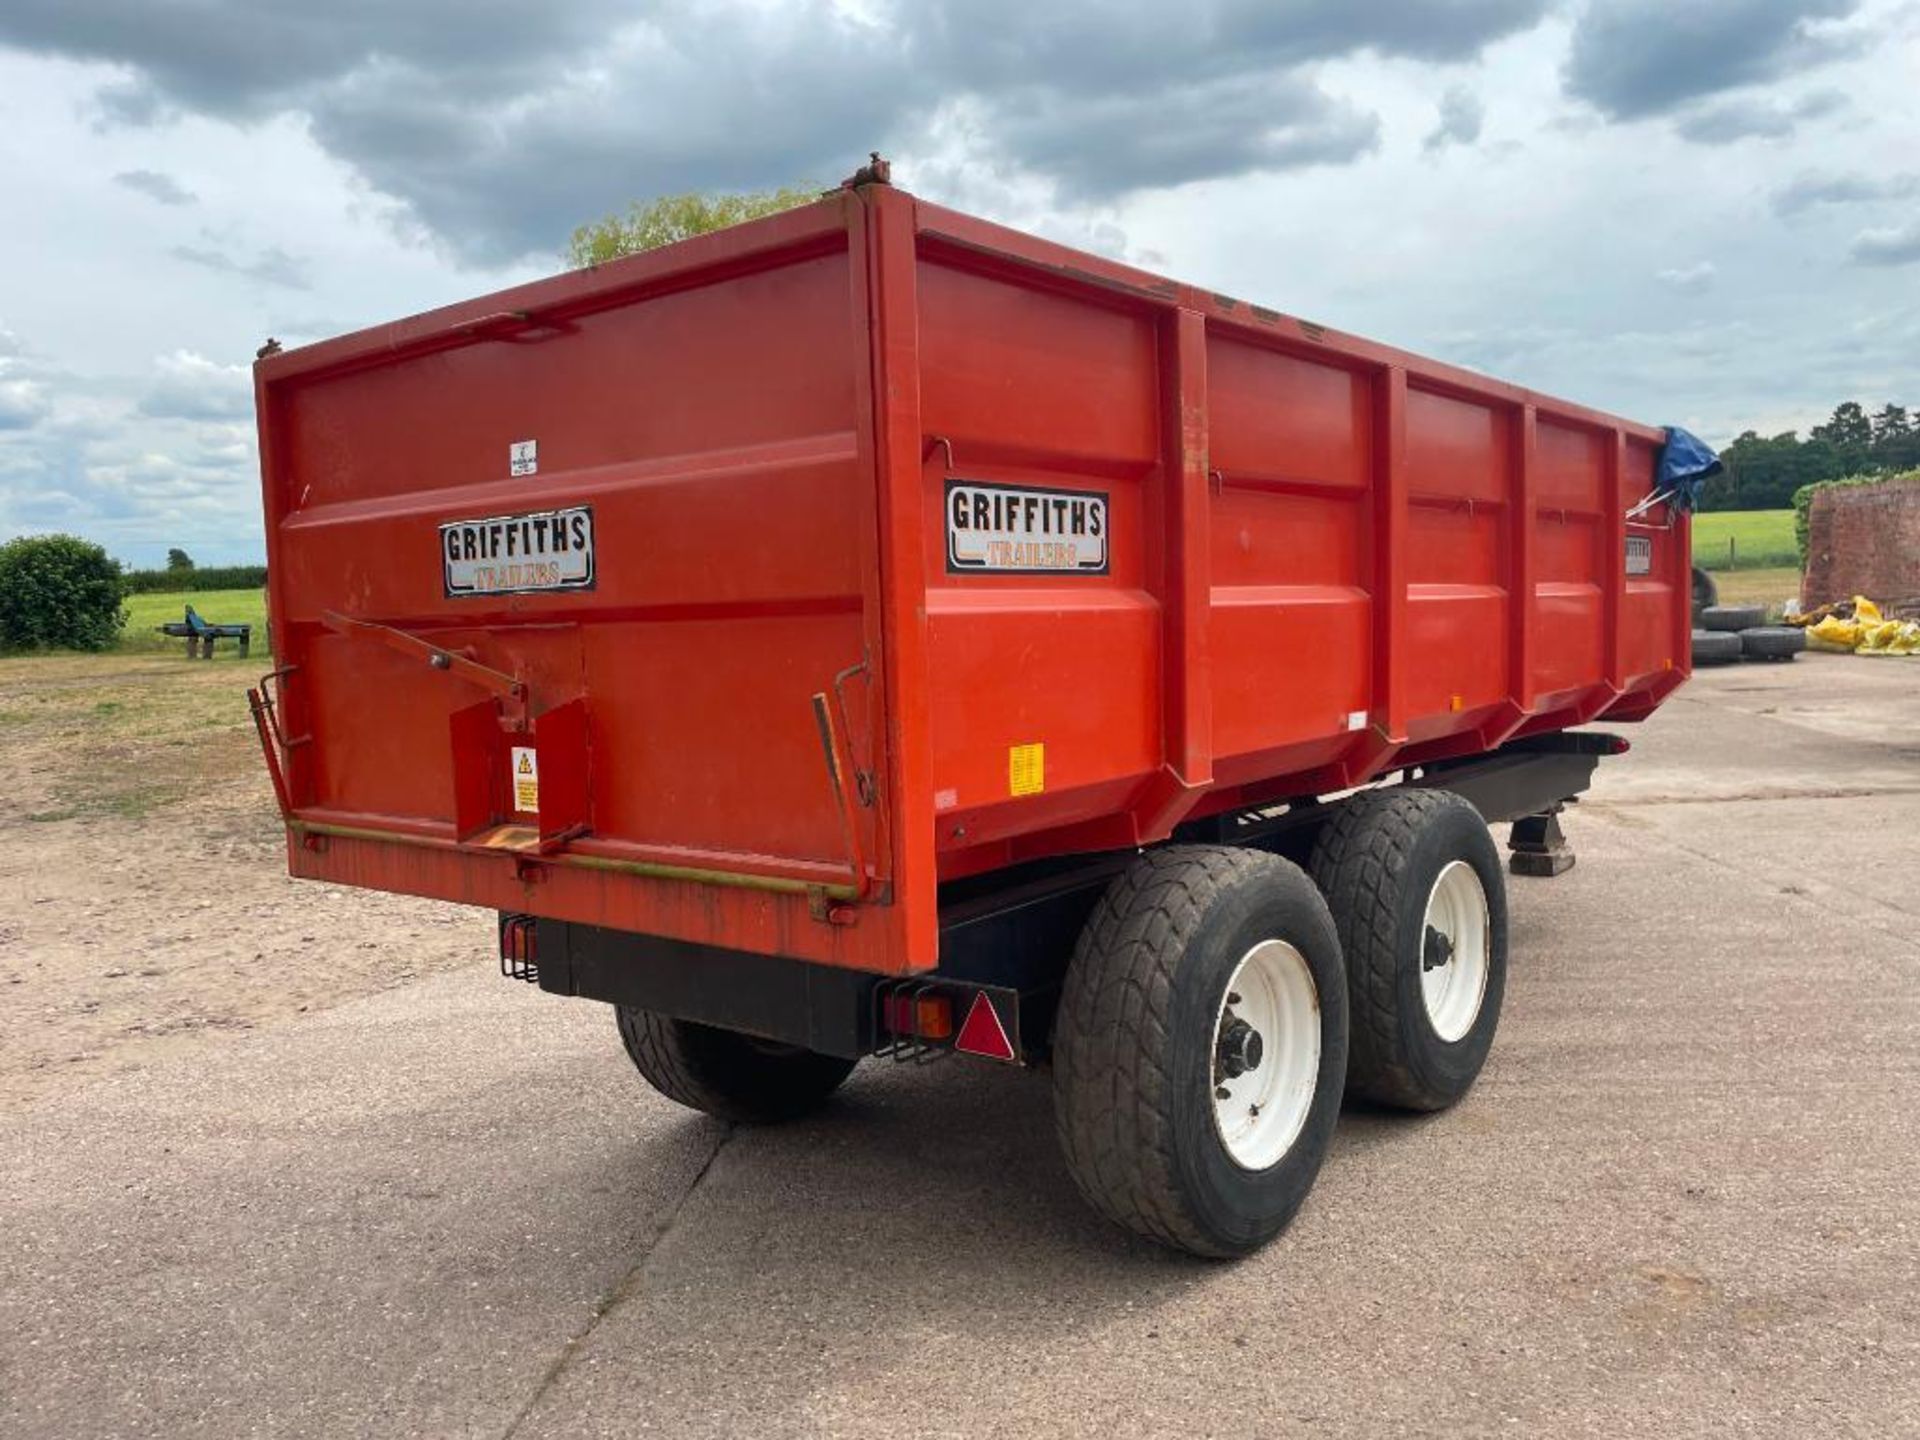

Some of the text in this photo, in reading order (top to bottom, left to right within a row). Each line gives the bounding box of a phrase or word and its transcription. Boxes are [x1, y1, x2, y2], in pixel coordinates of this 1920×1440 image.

[952, 491, 1101, 536] GRIFFITHS
[448, 516, 585, 561] GRIFFITHS
[987, 540, 1076, 568] TRAILERS
[474, 561, 560, 590] TRAILERS
